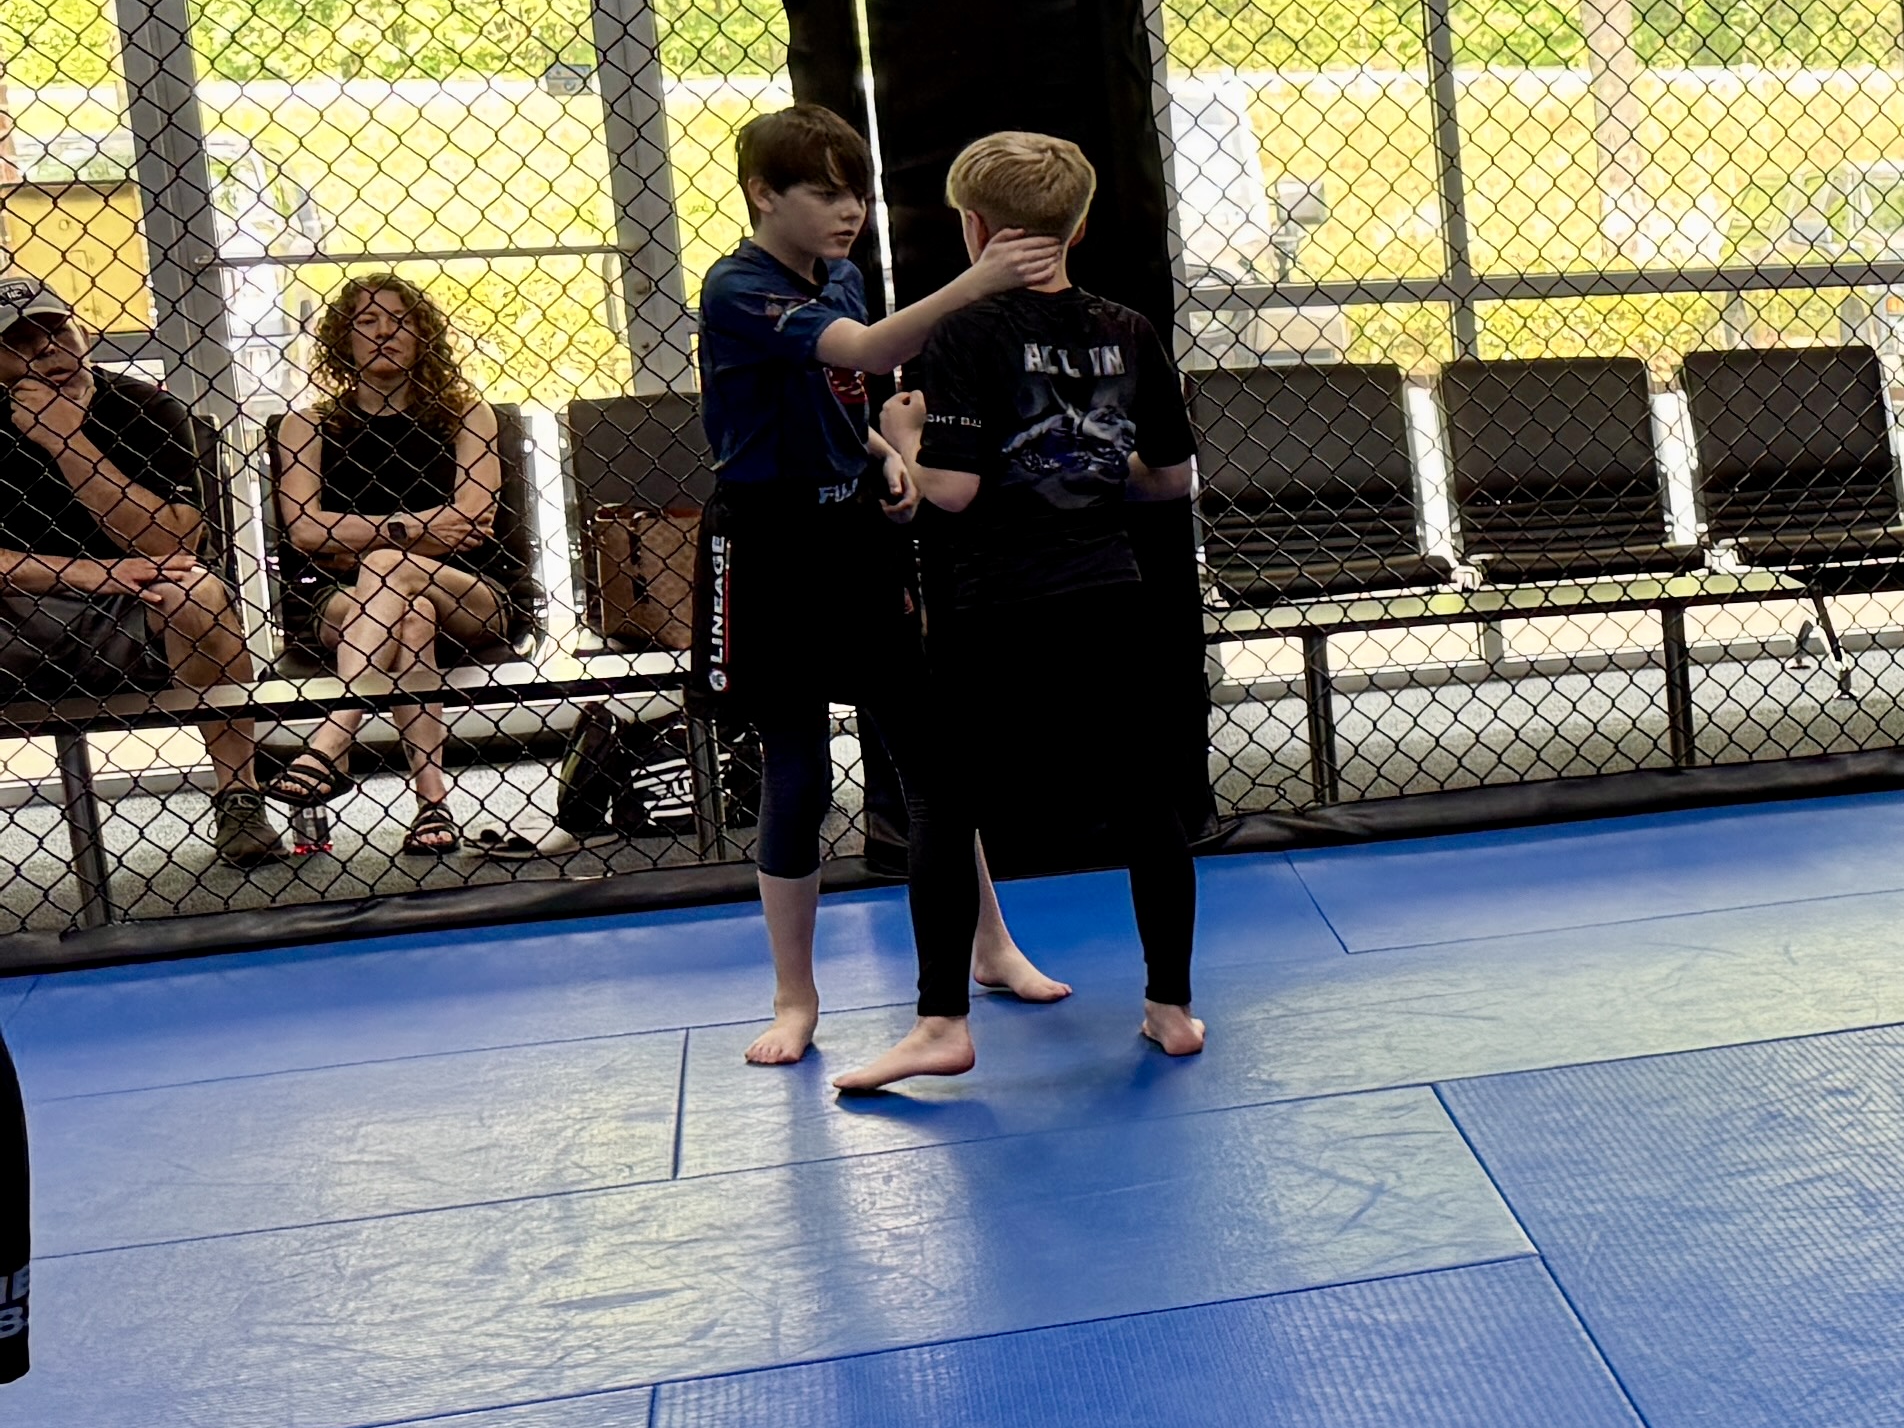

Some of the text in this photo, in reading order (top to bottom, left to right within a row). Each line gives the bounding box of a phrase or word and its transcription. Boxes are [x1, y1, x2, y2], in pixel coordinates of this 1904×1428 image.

[1024, 342, 1126, 379] ALL IN
[710, 535, 726, 664] LINEAGE
